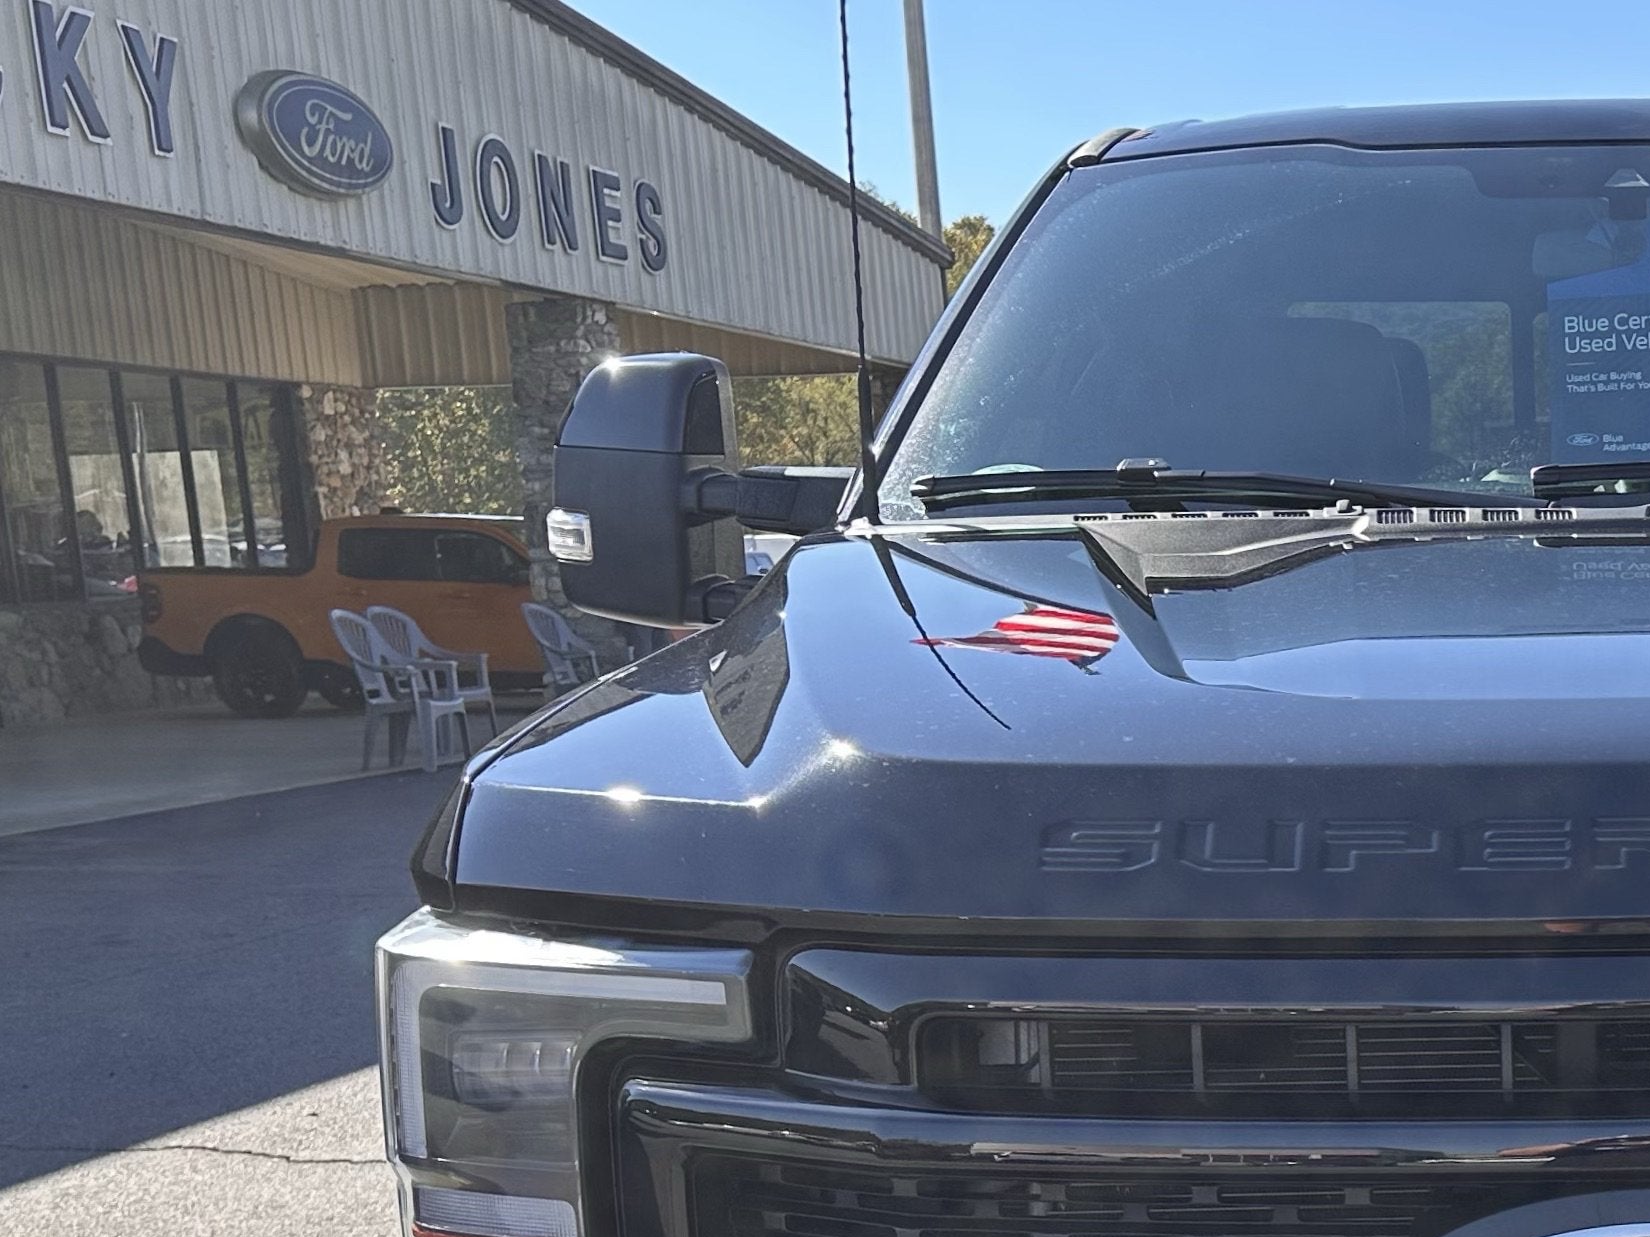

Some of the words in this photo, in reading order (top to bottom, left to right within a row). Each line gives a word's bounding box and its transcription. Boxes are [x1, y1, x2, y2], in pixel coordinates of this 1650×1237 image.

[0, 0, 179, 158] KY
[300, 98, 375, 173] Ford
[429, 121, 668, 275] JONES
[1564, 315, 1609, 333] Blue
[1564, 333, 1617, 353] Used
[1566, 373, 1591, 382] Used
[1591, 372, 1608, 381] Car
[1610, 371, 1642, 381] Buying
[1566, 384, 1596, 393] That's
[1598, 382, 1618, 392] Built
[1620, 381, 1636, 390] For
[1602, 433, 1624, 443] Blue
